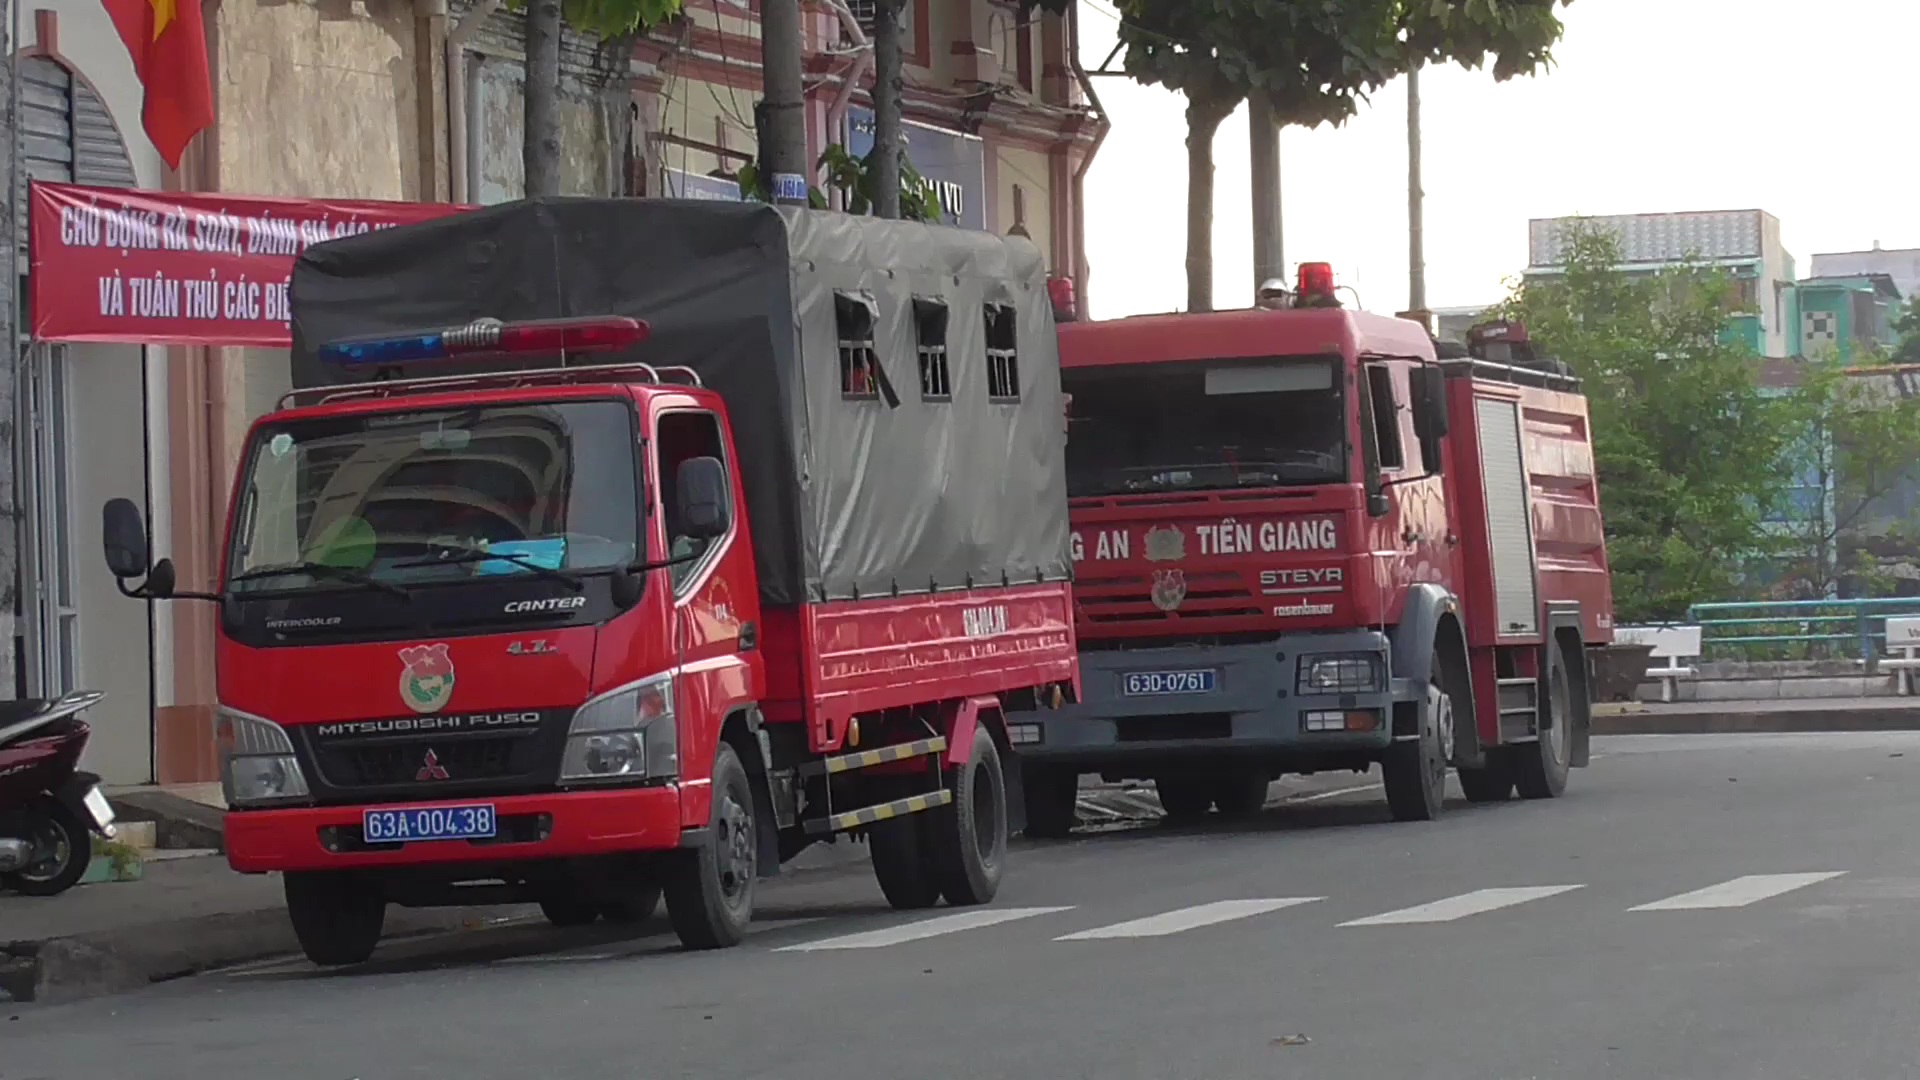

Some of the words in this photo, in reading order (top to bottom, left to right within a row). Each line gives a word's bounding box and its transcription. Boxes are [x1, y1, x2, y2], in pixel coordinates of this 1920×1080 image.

[61, 195, 100, 247] CHỦ
[105, 202, 159, 257] ĐỘNG
[163, 205, 189, 250] RÀ
[99, 268, 124, 316] VÀ
[128, 270, 179, 318] TUÂN
[184, 267, 219, 319] THỦ
[223, 273, 260, 320] CÁC
[1095, 530, 1129, 560] AN
[1196, 518, 1252, 554] TIỀN
[1259, 519, 1337, 552] GIANG
[1260, 567, 1343, 584] STEYR
[503, 596, 587, 613] CANTER
[1130, 673, 1204, 692] 63D-0761
[318, 715, 461, 736] MITSUBISHI
[469, 711, 540, 726] FUSO
